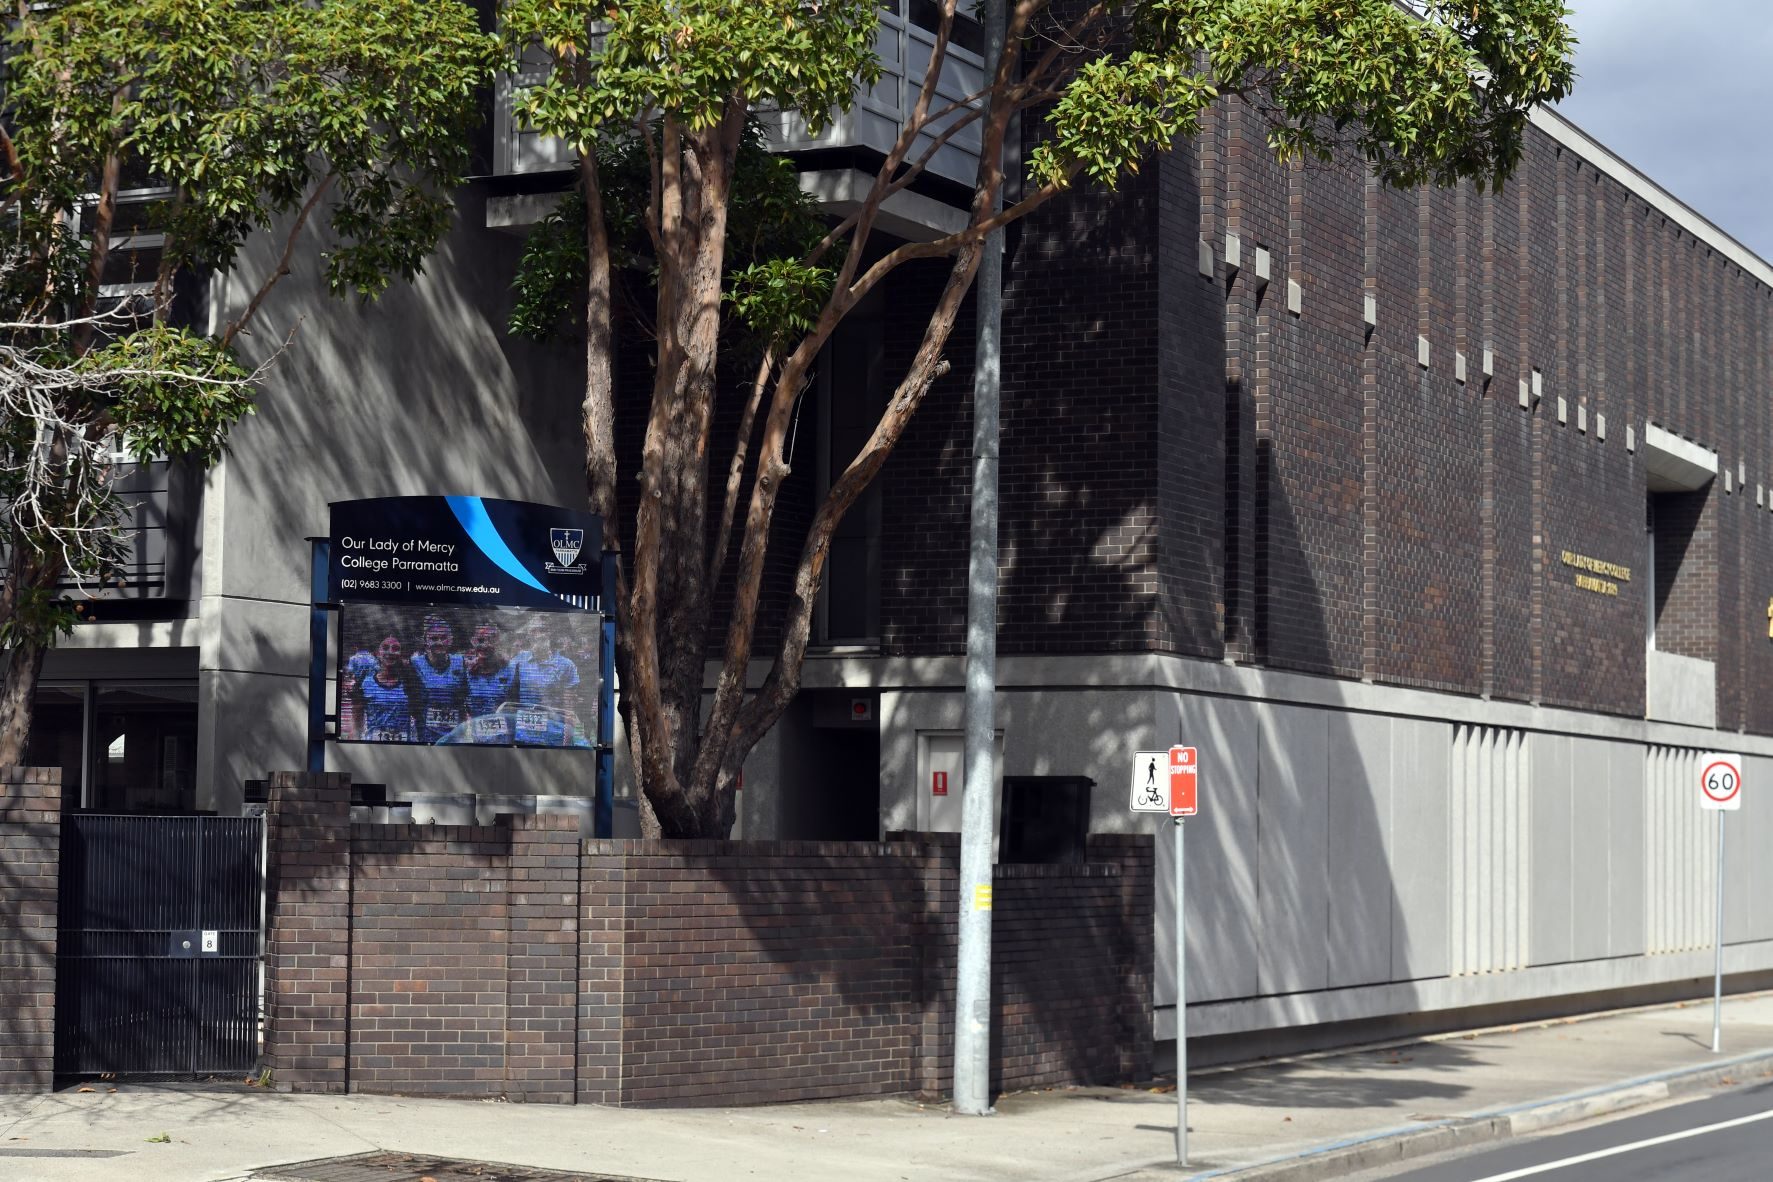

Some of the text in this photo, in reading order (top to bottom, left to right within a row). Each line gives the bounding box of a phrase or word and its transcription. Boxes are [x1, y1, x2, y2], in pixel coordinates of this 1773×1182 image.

[341, 537, 455, 556] Our Lady of Mercy
[553, 540, 580, 549] OLMC
[341, 555, 459, 572] College Parramatta
[341, 579, 500, 594] (02) 9683 3300 www.olmc.nsw.edu.au
[1177, 752, 1188, 763] NO
[1170, 765, 1196, 775] STOPPING
[1708, 773, 1734, 790] 60
[206, 940, 212, 948] 8
